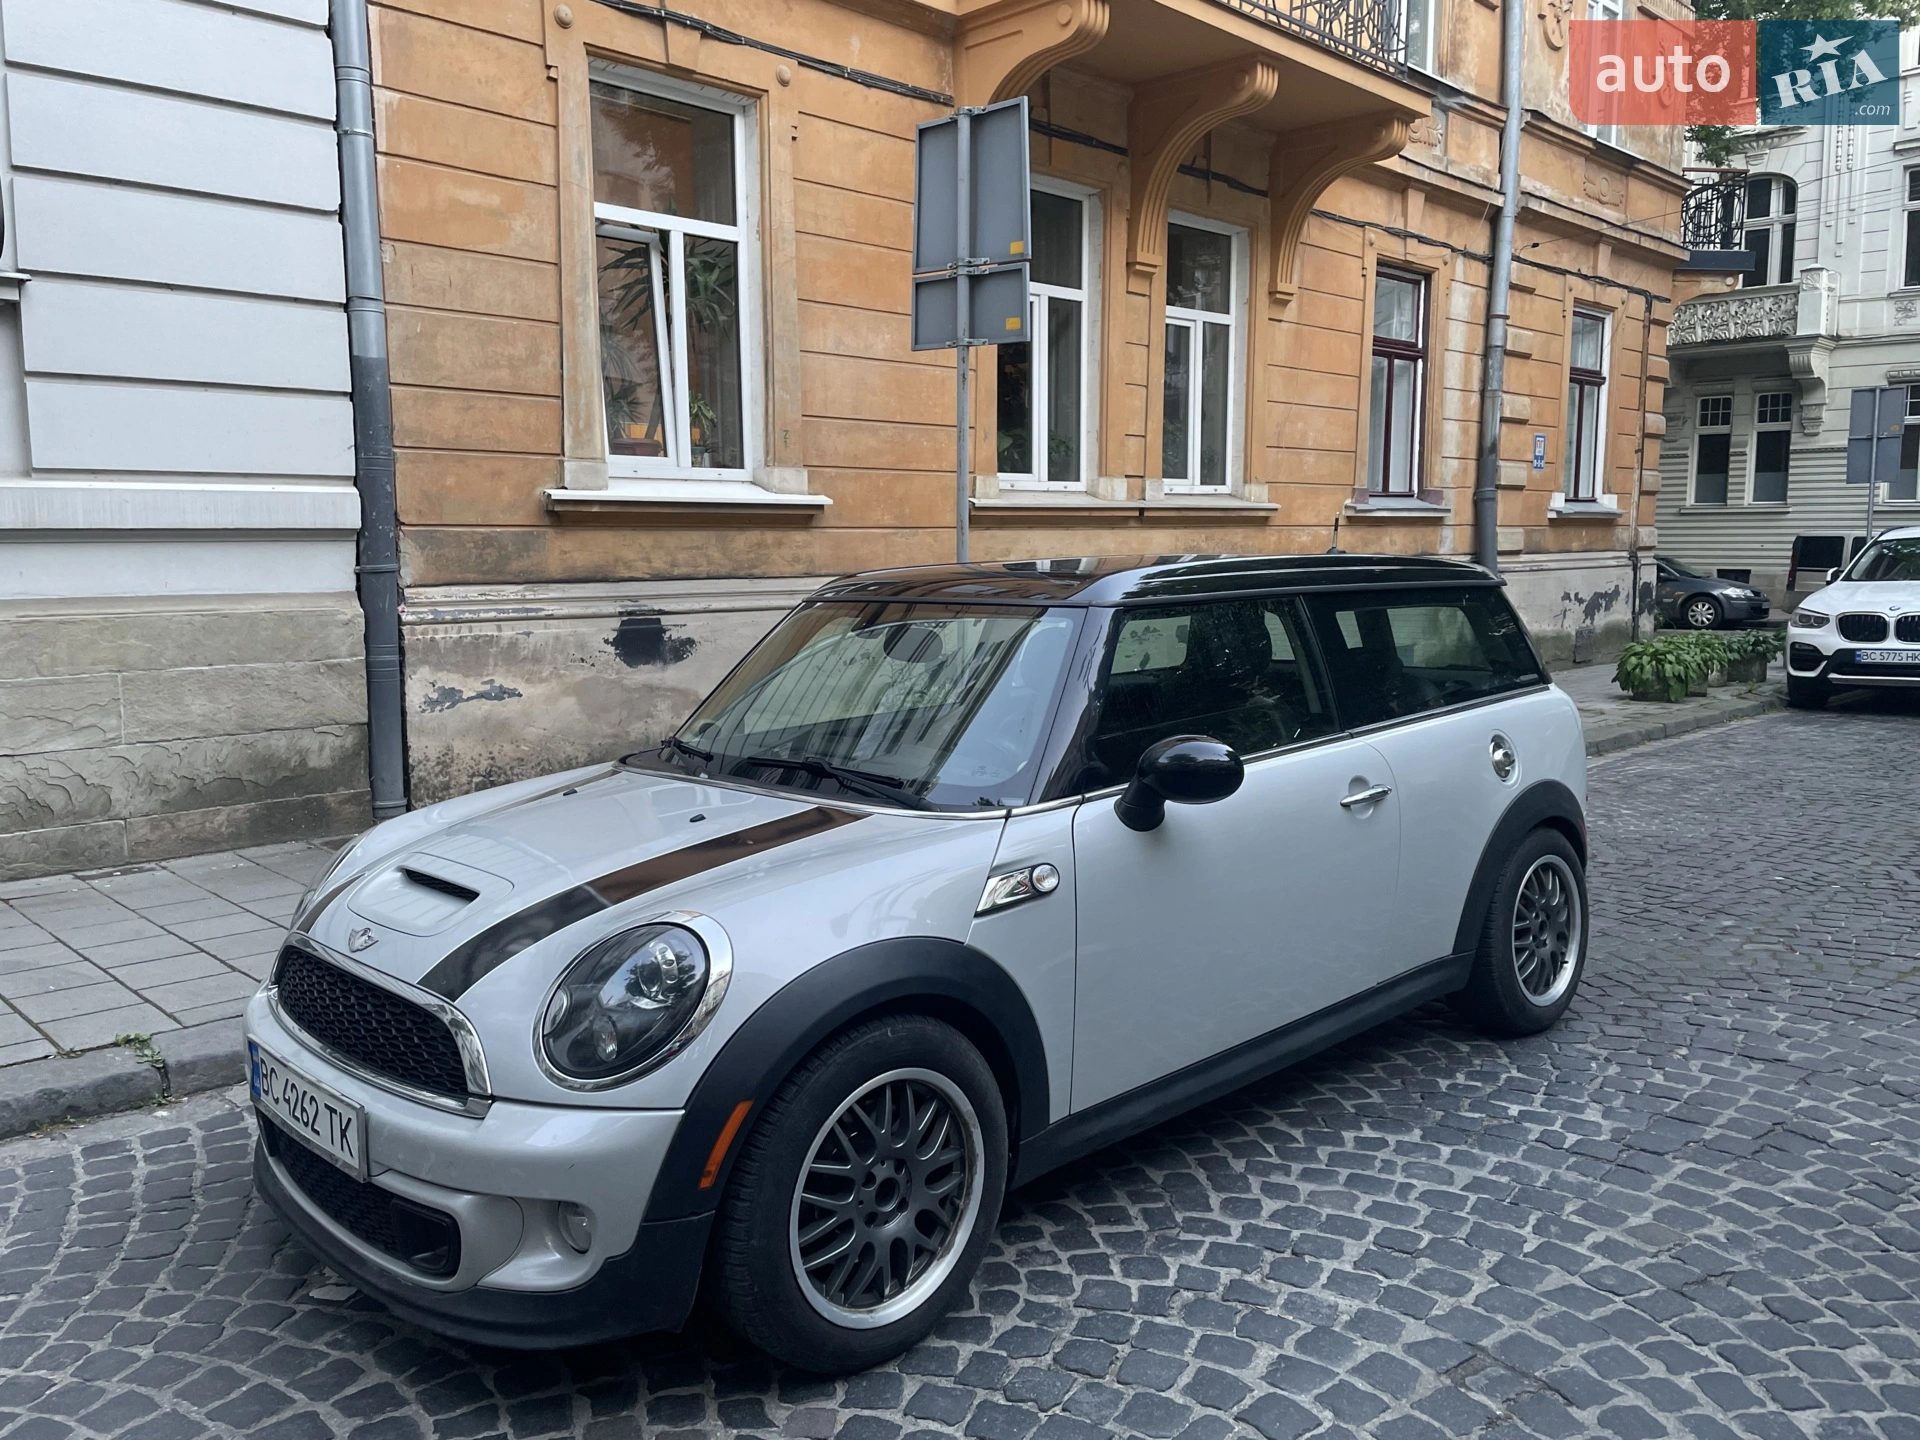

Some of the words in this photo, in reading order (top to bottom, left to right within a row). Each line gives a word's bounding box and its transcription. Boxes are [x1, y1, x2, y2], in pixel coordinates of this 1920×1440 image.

[1861, 651, 1877, 661] BC
[1879, 651, 1904, 662] 5775
[260, 1056, 280, 1106] BC
[282, 1077, 321, 1137] 4262
[324, 1102, 354, 1159] TK
